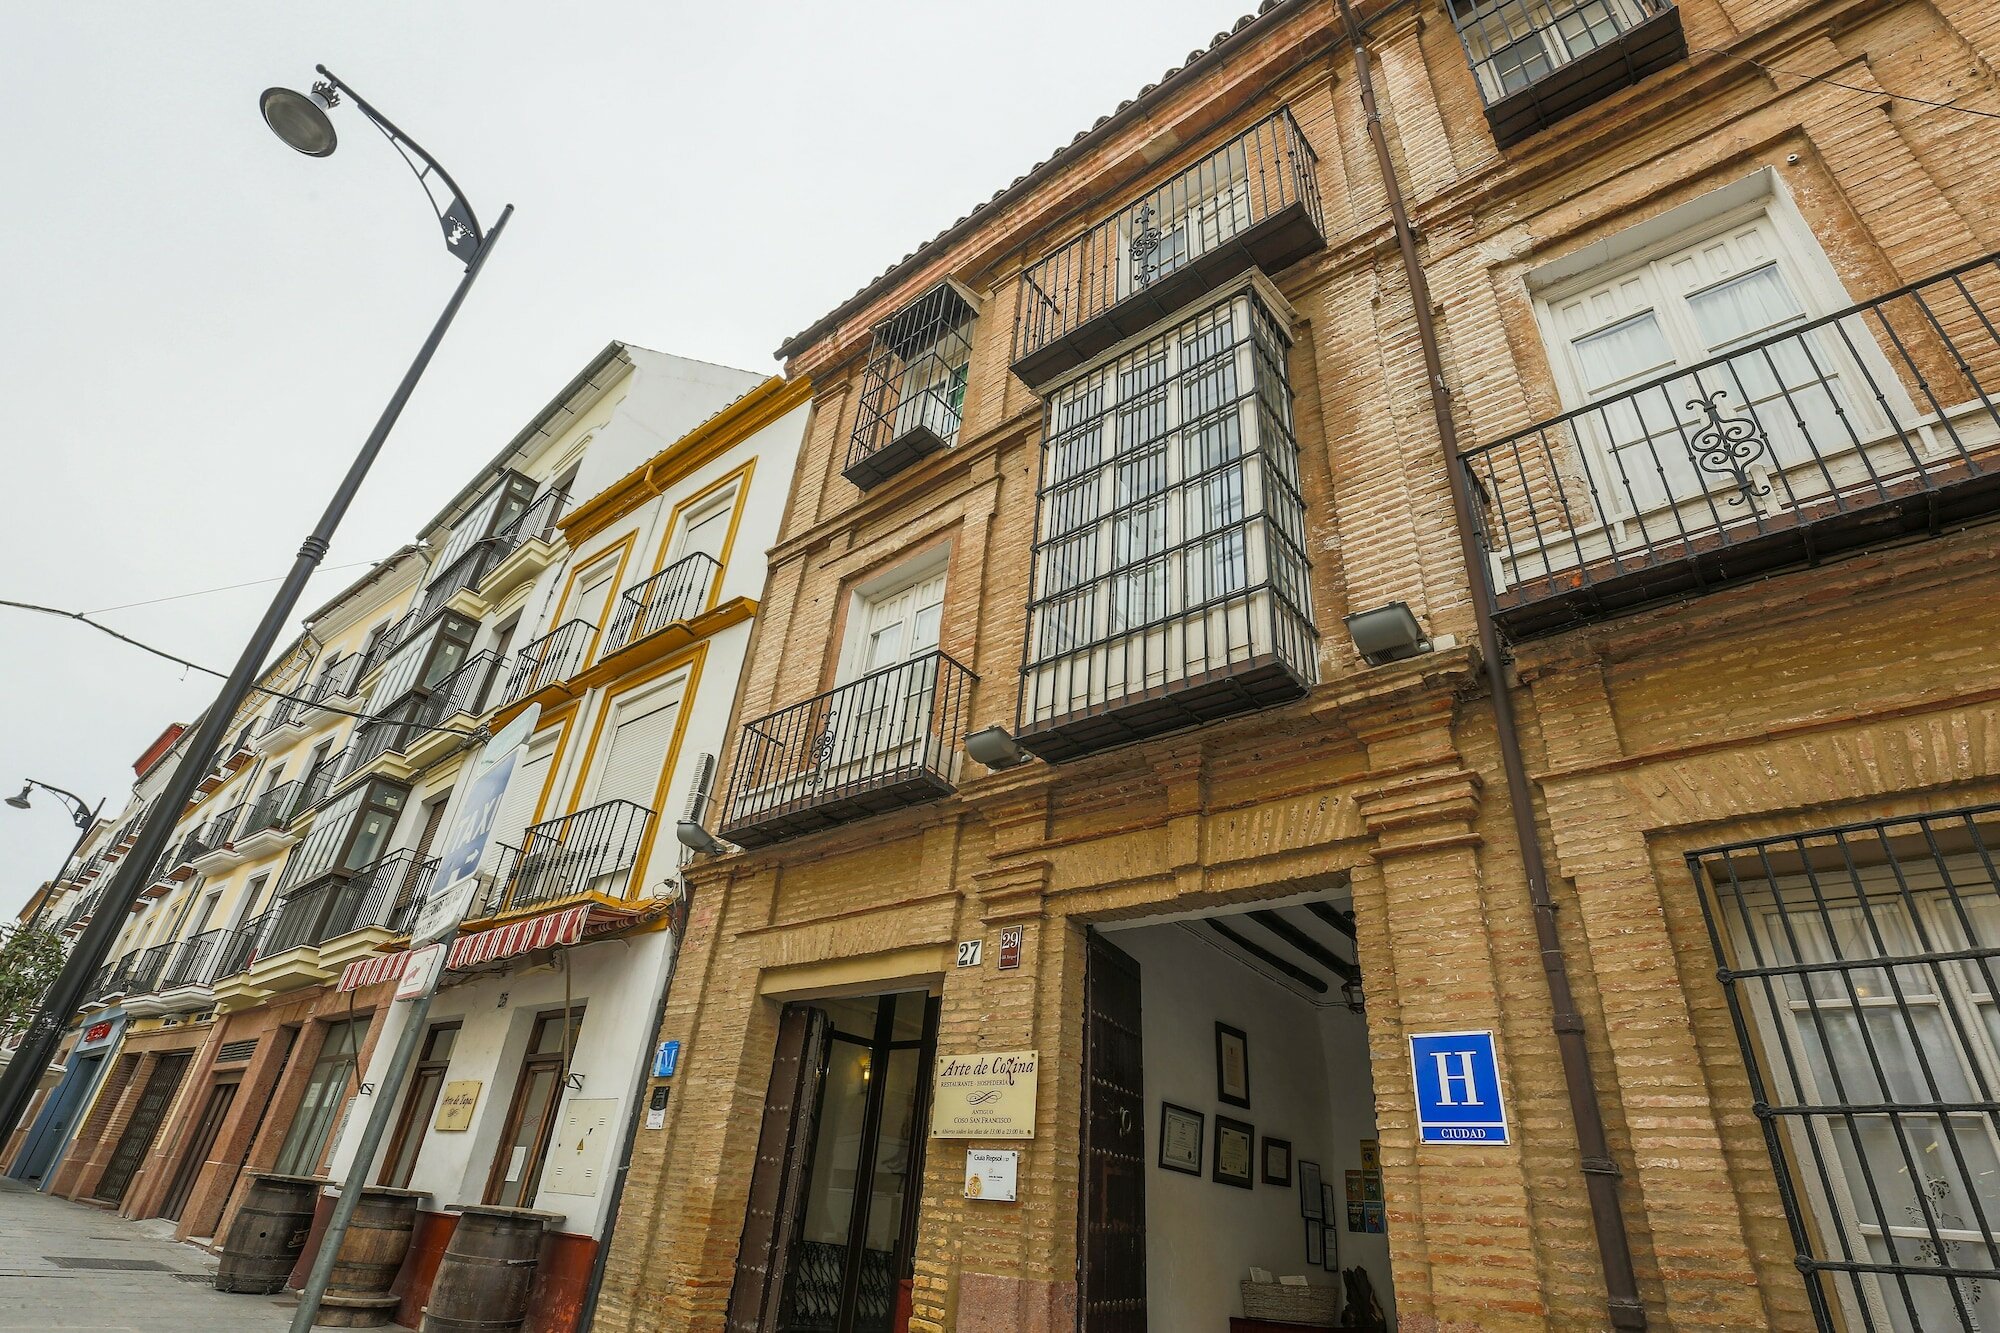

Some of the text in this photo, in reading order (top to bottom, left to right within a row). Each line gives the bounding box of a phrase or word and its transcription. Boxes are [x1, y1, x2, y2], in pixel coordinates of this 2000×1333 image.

[451, 792, 504, 853] TAXI
[1002, 932, 1018, 949] 29
[958, 941, 981, 966] 27
[941, 1059, 972, 1077] Arte
[973, 1057, 988, 1075] de
[941, 1080, 974, 1088] RESTAURANTE
[1430, 1051, 1484, 1106] H
[442, 1096, 454, 1105] Arte
[1441, 1128, 1486, 1139] CIUDAD
[986, 1154, 1002, 1163] Repsol
